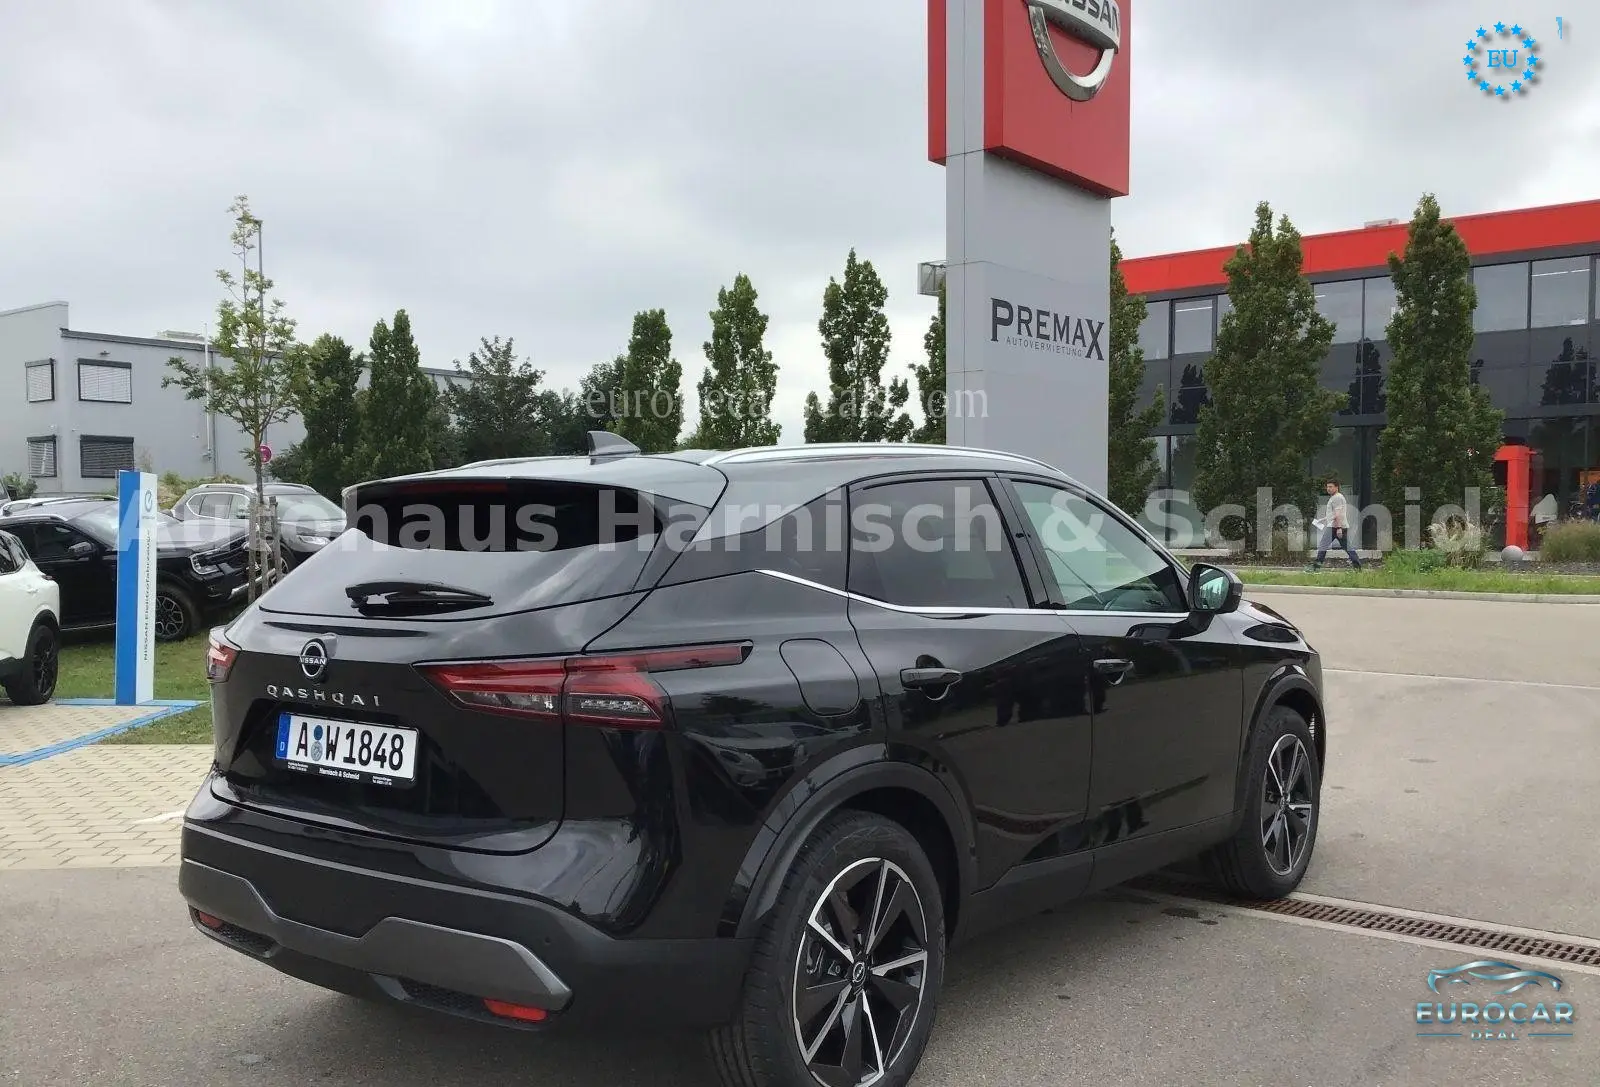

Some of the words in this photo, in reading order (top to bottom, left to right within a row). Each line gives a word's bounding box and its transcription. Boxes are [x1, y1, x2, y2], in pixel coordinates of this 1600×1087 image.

[1059, 0, 1120, 37] SSAN
[990, 297, 1105, 361] PREMAX
[1006, 336, 1082, 358] AUTOVERMIETUNG
[266, 684, 381, 707] QASHQAI
